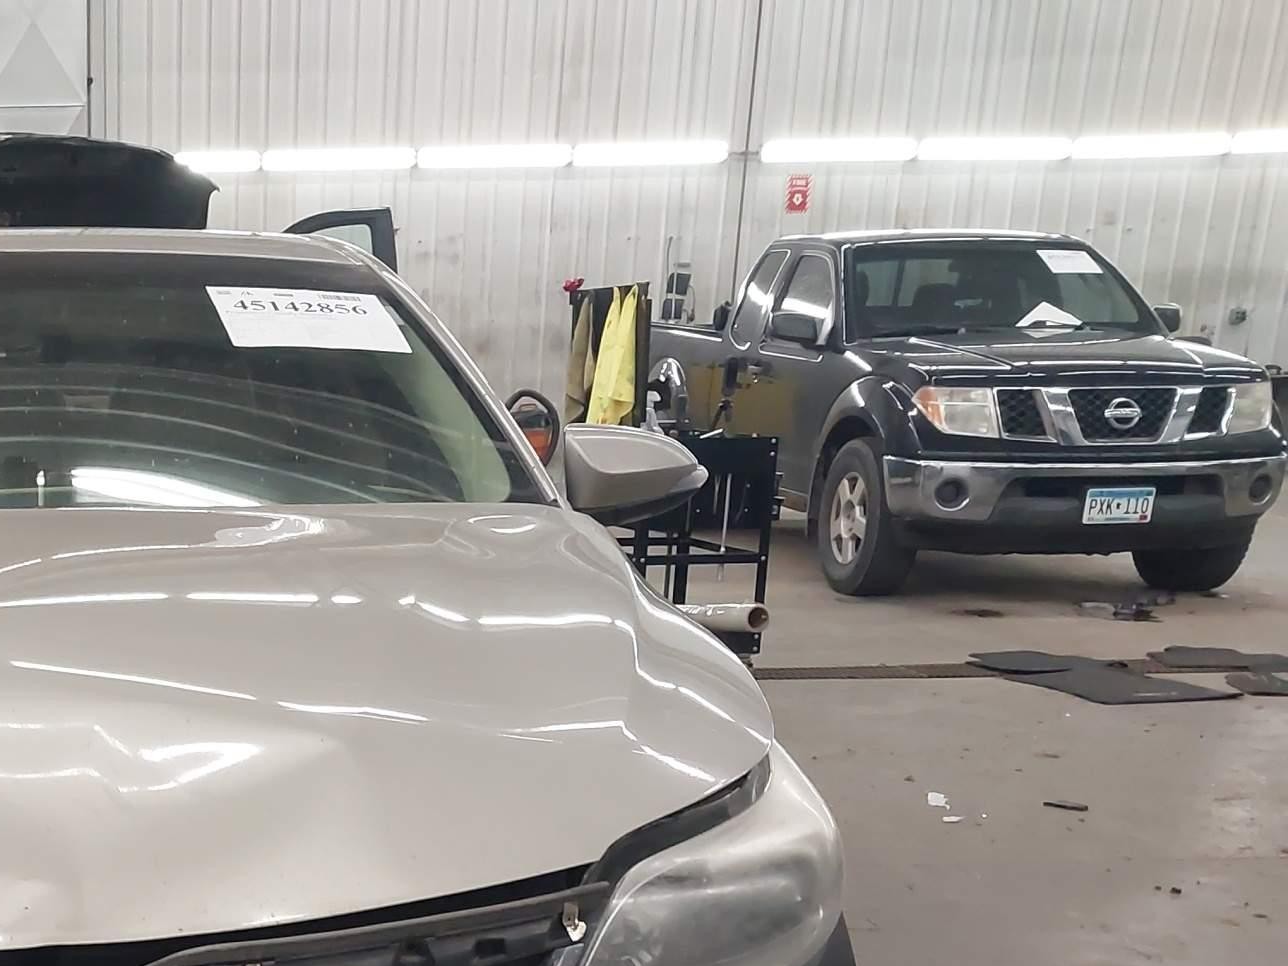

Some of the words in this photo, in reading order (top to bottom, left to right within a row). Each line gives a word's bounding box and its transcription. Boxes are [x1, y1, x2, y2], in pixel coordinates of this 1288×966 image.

[232, 299, 368, 315] 45142856
[1088, 498, 1115, 515] PXK
[1123, 497, 1150, 514] 110
